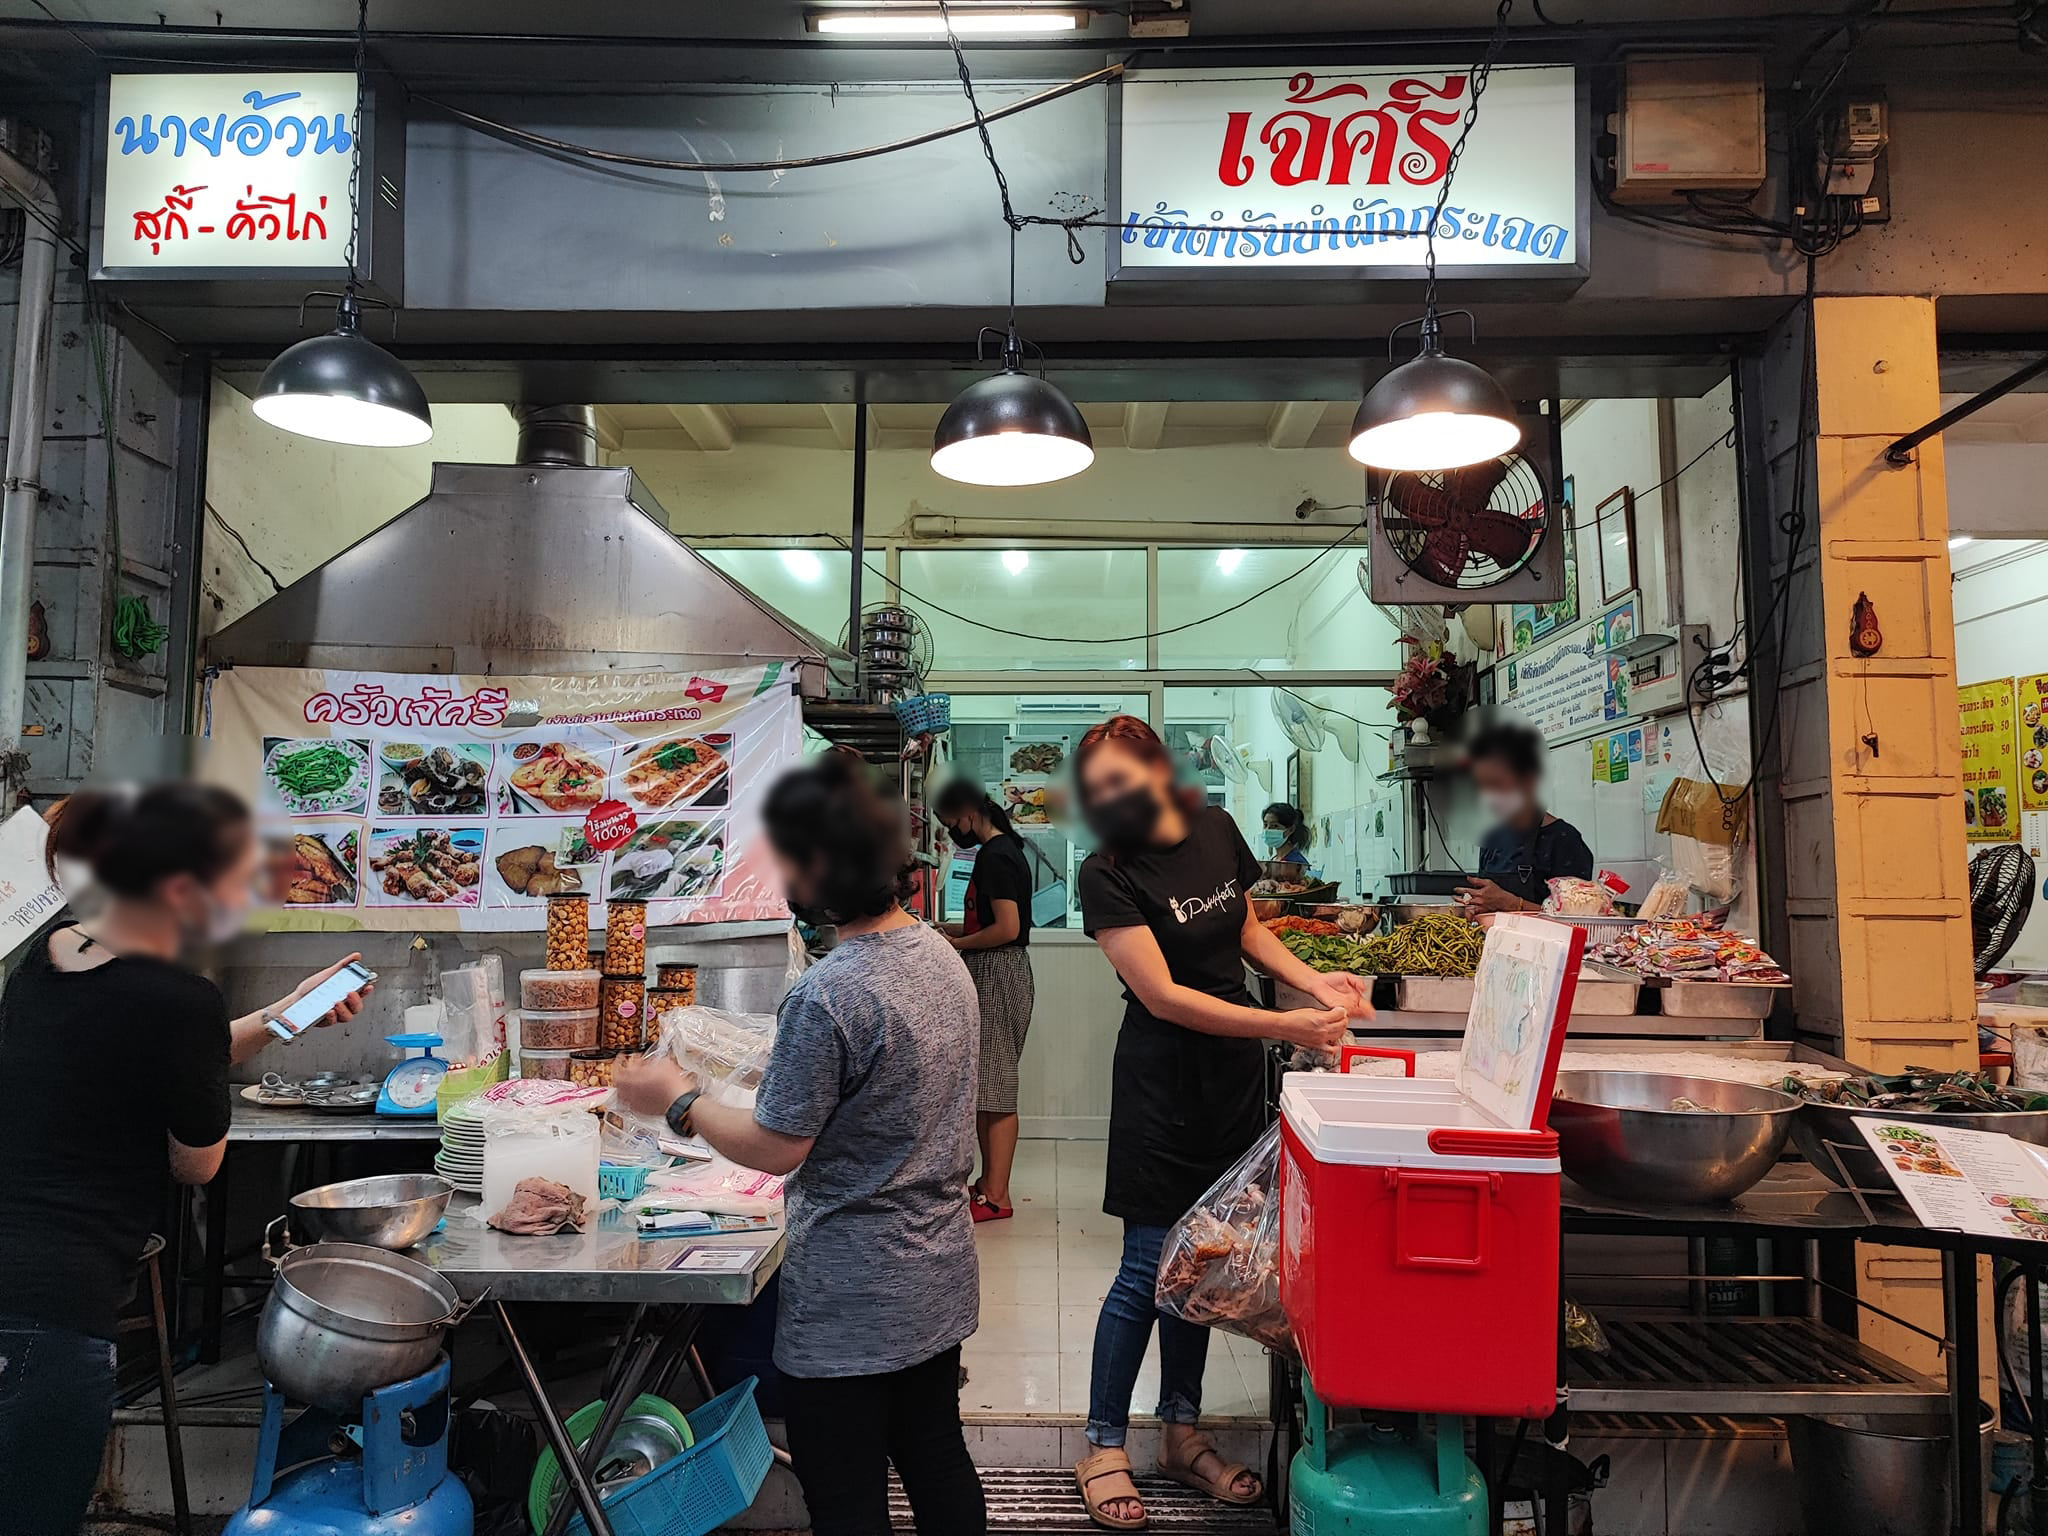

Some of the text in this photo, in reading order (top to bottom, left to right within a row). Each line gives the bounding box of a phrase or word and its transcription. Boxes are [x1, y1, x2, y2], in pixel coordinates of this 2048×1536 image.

[114, 91, 352, 157] นายอ้วน
[1218, 72, 1468, 187] เจ้ศรี
[133, 185, 208, 255] สุกี้
[226, 185, 328, 241] คั่วไก่
[1121, 197, 1569, 260] เจ้าตำรับยำผักกระเฉด
[304, 684, 509, 726] ครัวเจ้ศรี
[2001, 743, 2010, 756] 50
[592, 822, 631, 843] 100%
